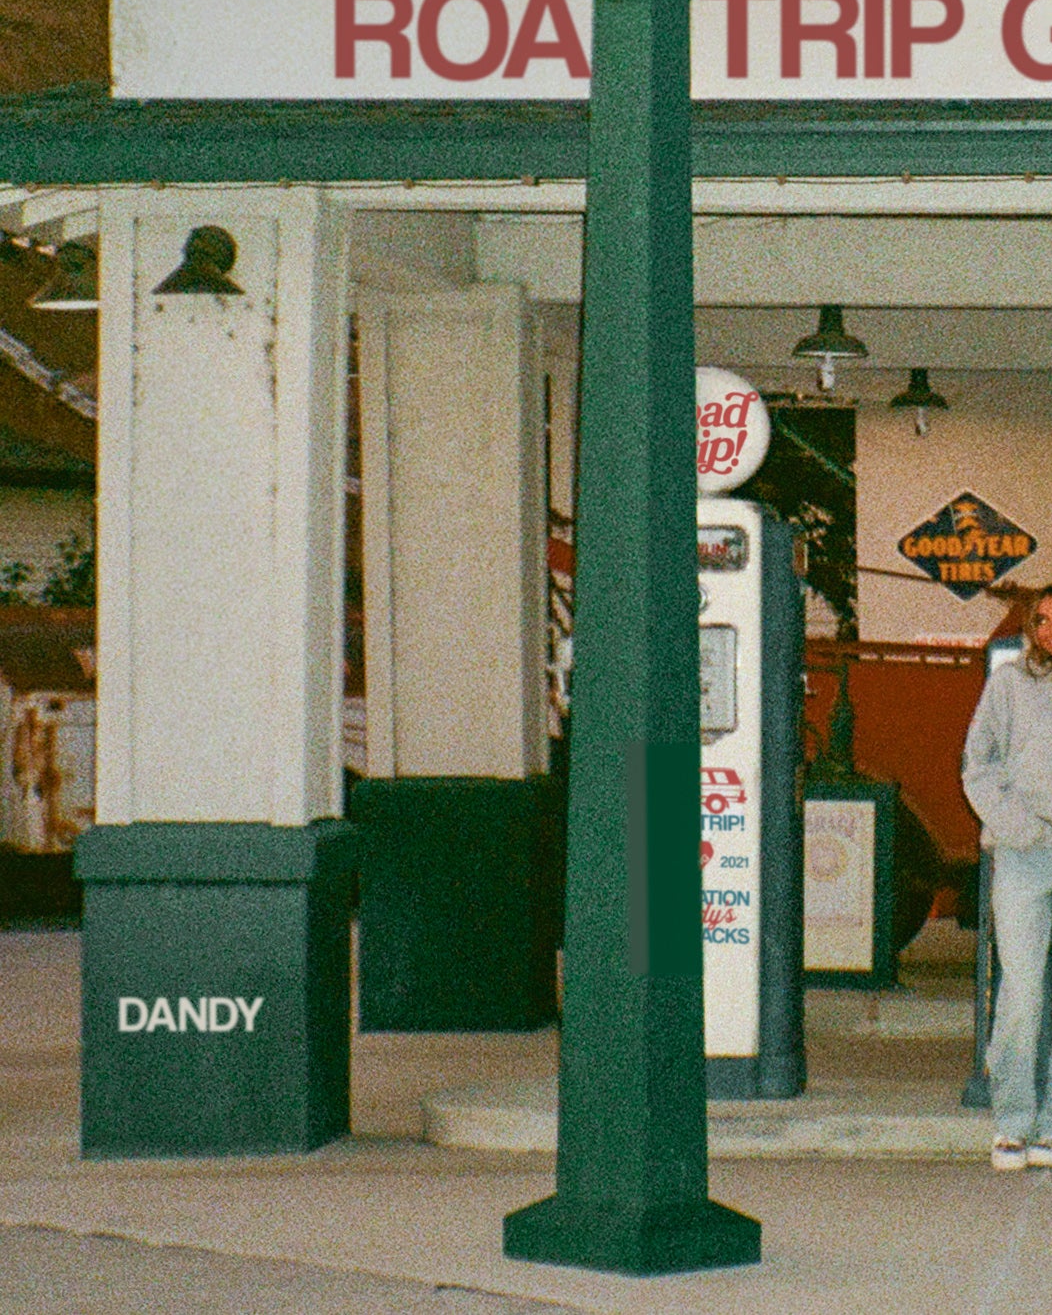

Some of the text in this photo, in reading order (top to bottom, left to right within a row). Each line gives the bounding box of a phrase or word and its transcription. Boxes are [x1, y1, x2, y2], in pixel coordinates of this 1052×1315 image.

[696, 391, 760, 430] ad
[696, 430, 748, 476] ip!
[903, 533, 1031, 558] GOODYEAR
[938, 562, 996, 582] TIRES
[720, 856, 750, 869] 2021
[701, 890, 751, 907] ATION
[701, 899, 738, 931] dy's
[702, 927, 751, 945] ACKS
[118, 996, 264, 1032] DANDY
